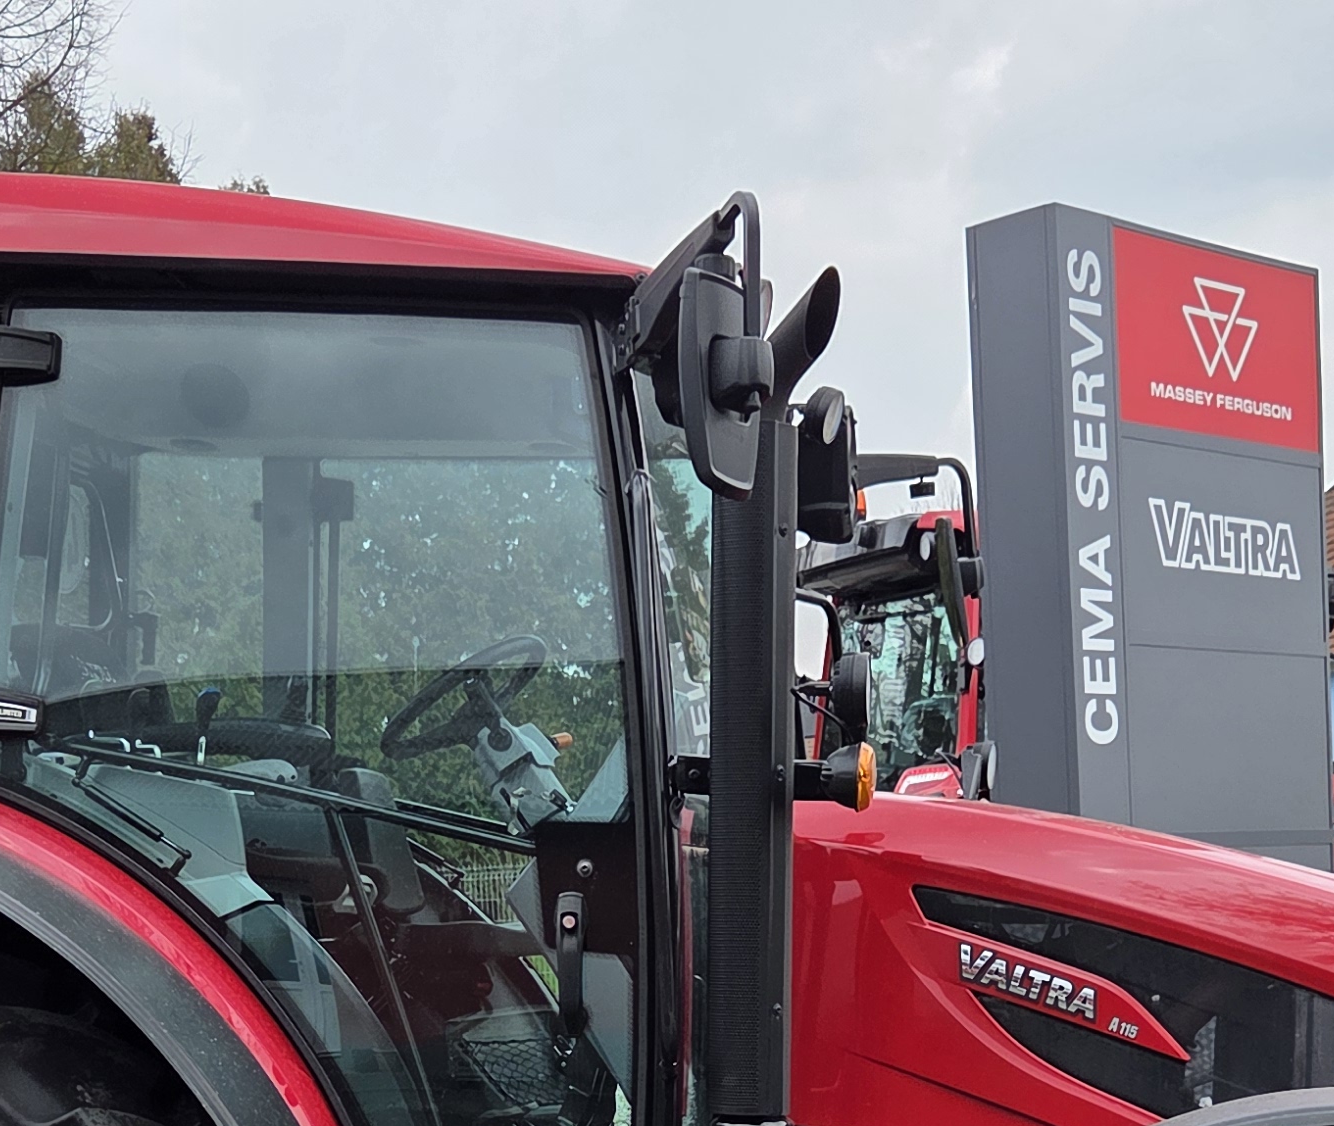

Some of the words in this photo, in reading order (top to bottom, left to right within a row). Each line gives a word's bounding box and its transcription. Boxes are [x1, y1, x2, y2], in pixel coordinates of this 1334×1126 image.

[1067, 248, 1111, 512] SERVIS
[1150, 381, 1214, 407] MASSEY
[1216, 394, 1292, 421] FERGUSON
[1148, 497, 1302, 581] VALTRA
[1078, 534, 1120, 745] CEMA
[959, 943, 1097, 1020] VALTRA
